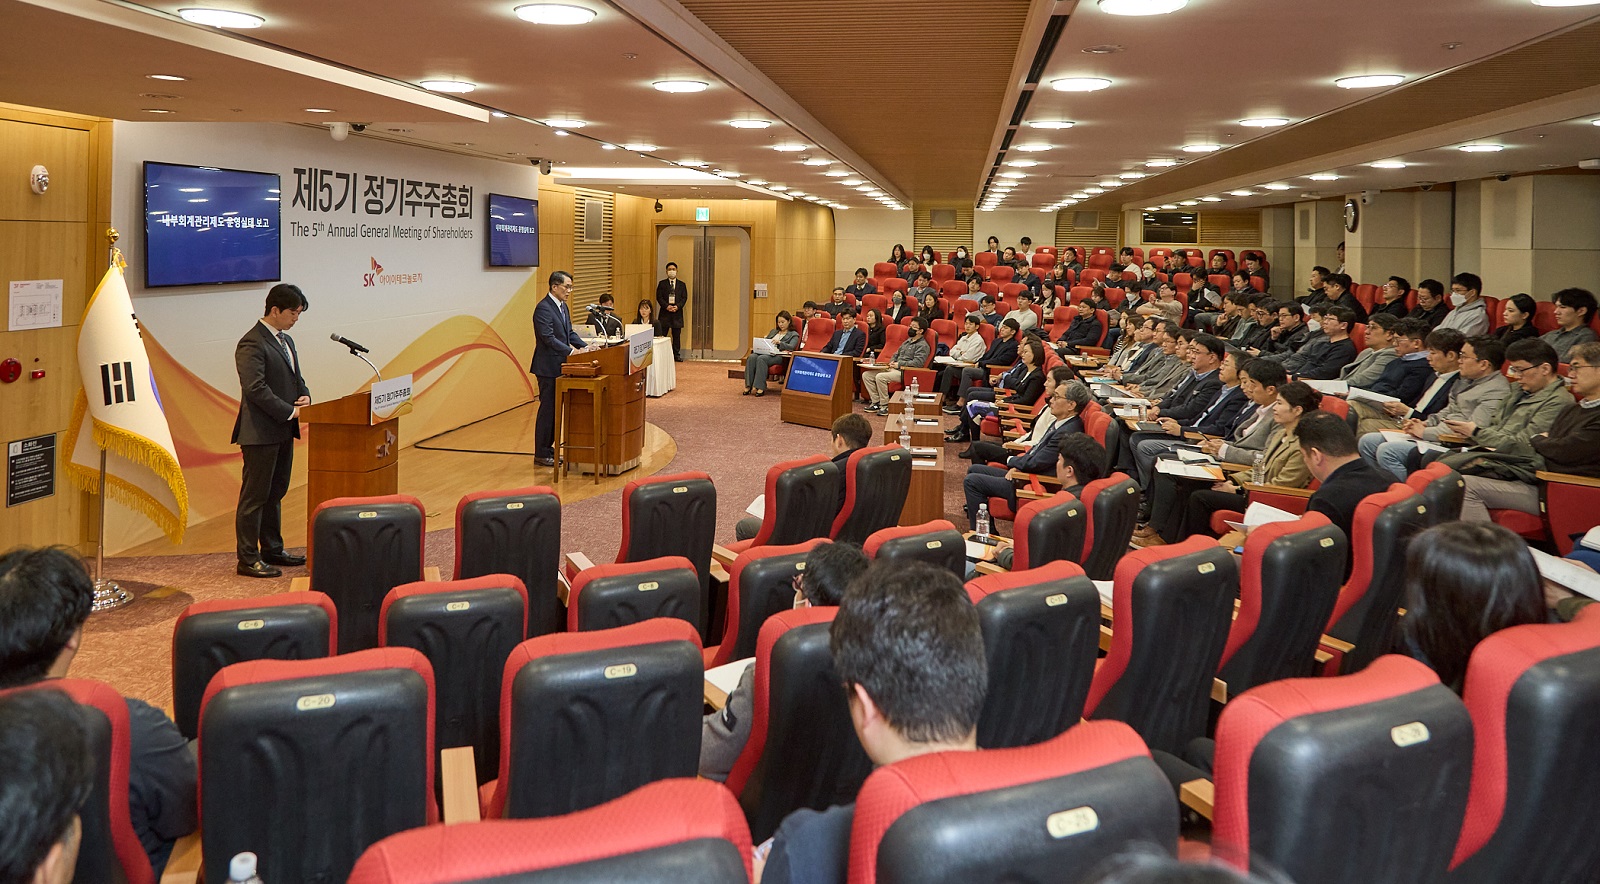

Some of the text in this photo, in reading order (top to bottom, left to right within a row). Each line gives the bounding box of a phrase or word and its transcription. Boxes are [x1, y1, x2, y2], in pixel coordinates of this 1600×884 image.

[292, 167, 473, 219] 제5기 정기주주총회
[162, 214, 225, 228] 내부회계관리제도
[256, 217, 270, 228] 보고
[290, 221, 473, 241] The 5th Annual General Meeting of Shareholders
[363, 273, 375, 287] SK
[451, 602, 465, 610] C-7
[610, 666, 632, 677] C-19
[303, 694, 330, 707] C-20
